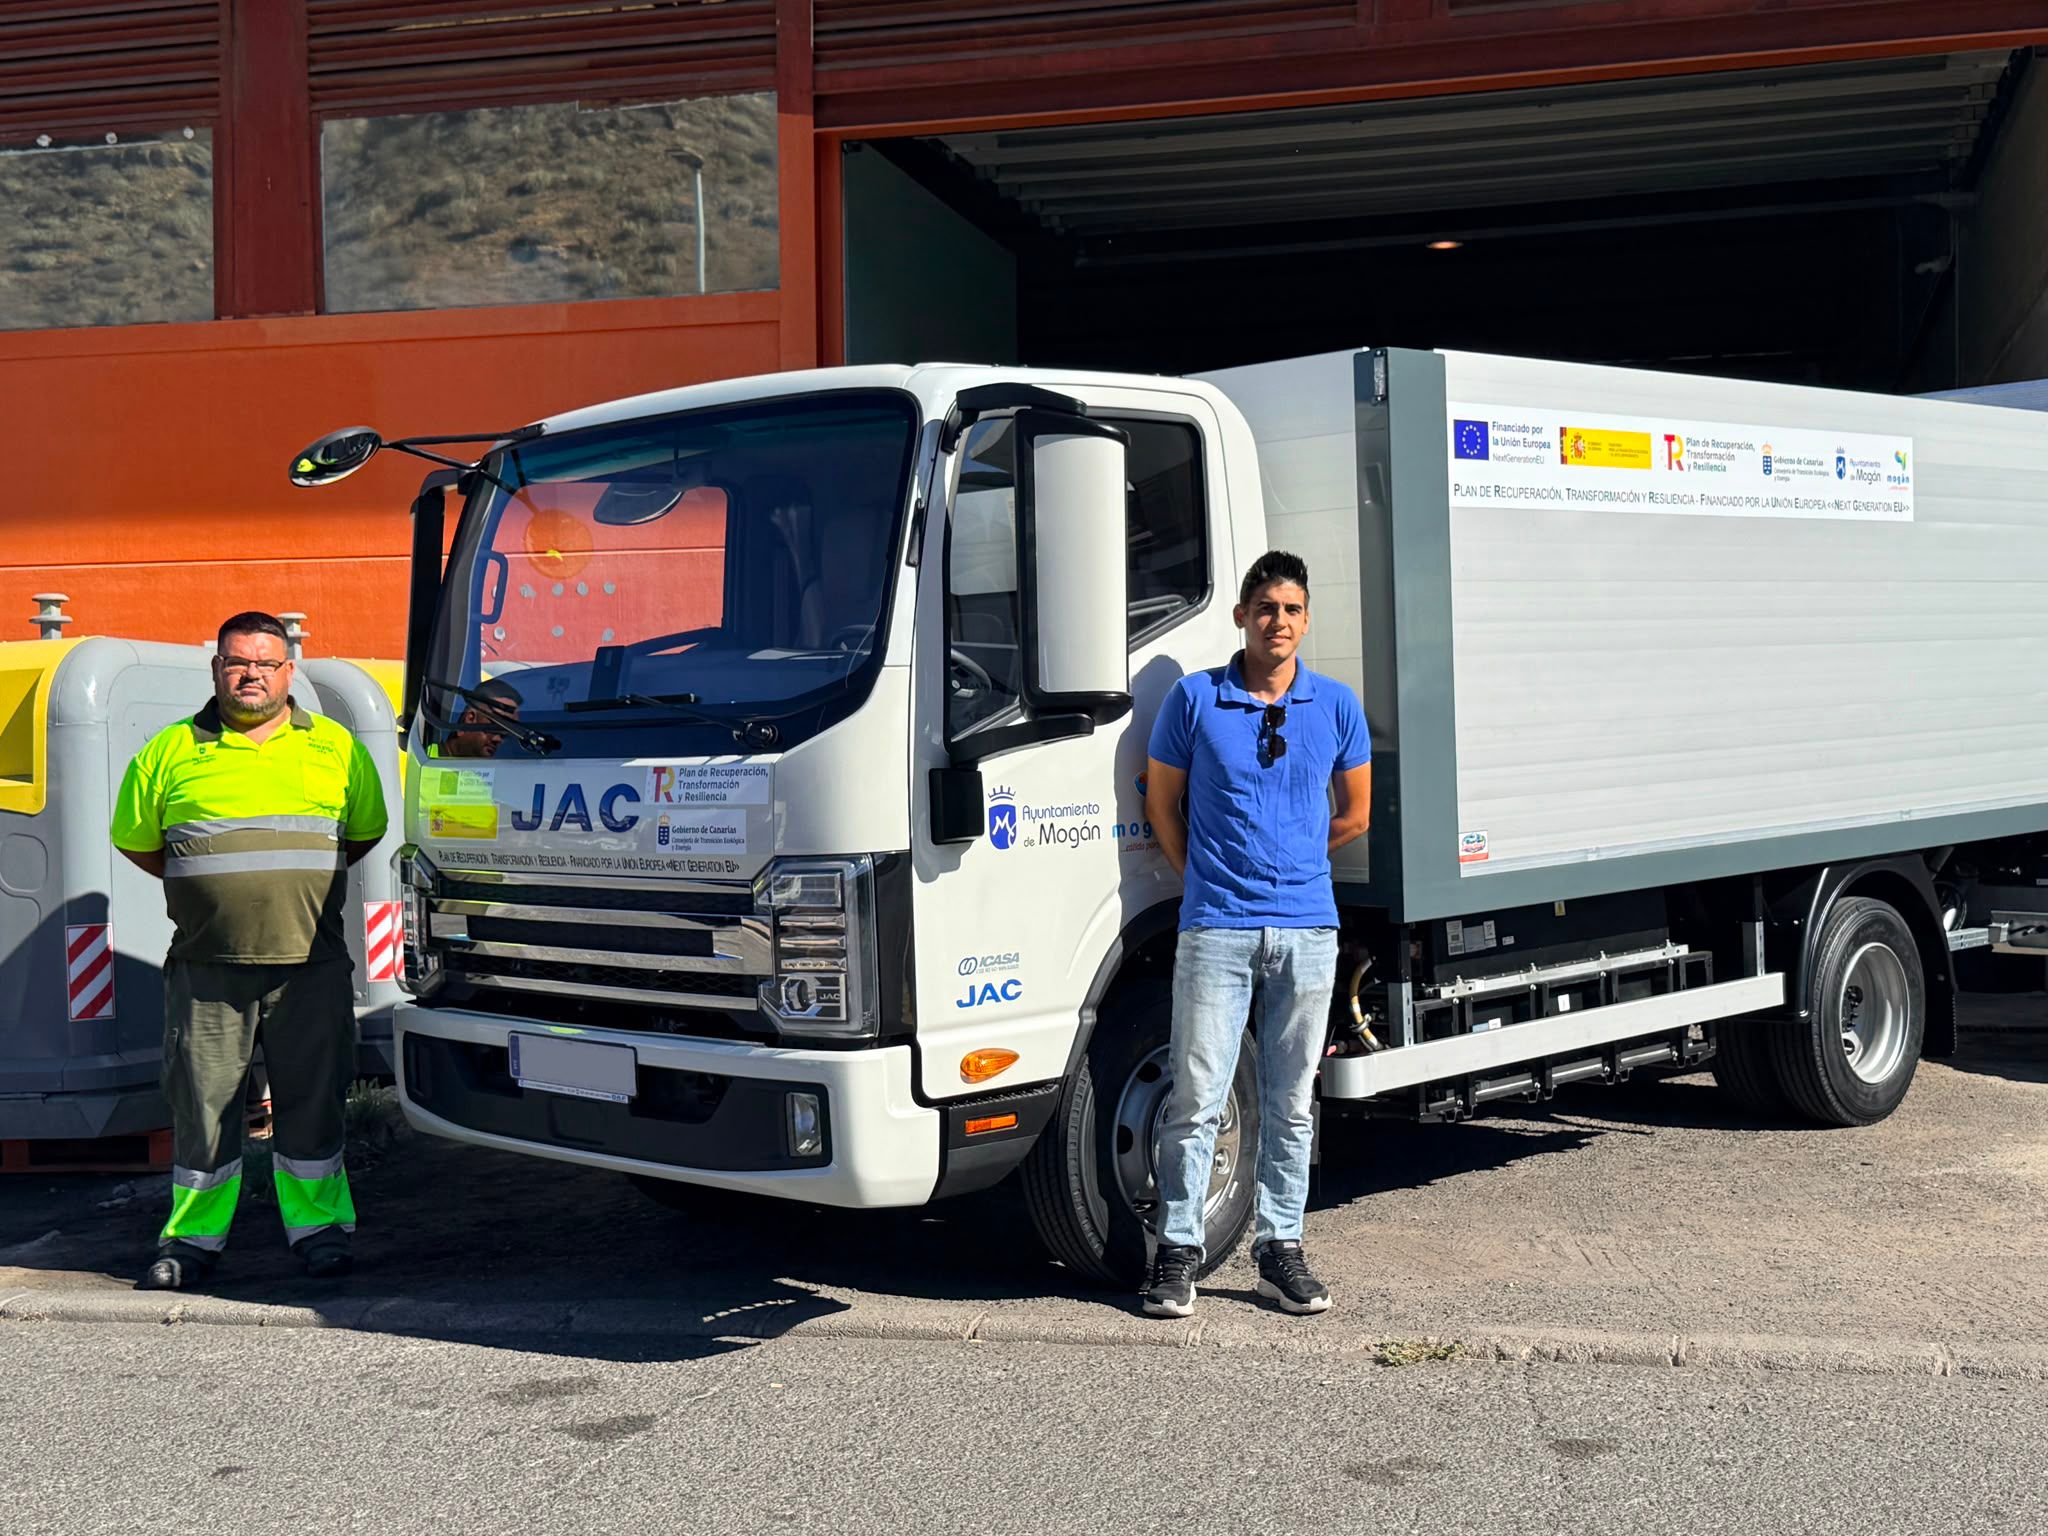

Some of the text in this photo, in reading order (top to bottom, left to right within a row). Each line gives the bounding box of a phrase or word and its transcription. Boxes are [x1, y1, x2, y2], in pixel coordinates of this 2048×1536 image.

[1492, 422, 1543, 435] Financiado por
[1492, 437, 1551, 450] la Unión Europea
[1686, 437, 1755, 452] Plan de Recuperación,
[1493, 454, 1544, 465] NextGenerationEU
[1686, 450, 1735, 462] Transformación
[1796, 457, 1802, 466] de
[1687, 462, 1727, 472] y Resiliencia
[1856, 468, 1881, 485] Mogán
[1454, 484, 1477, 497] PLAN
[1480, 486, 1492, 498] DE
[1494, 484, 1564, 502] RECUPERACIÓN,
[1566, 488, 1640, 504] TRANSFORMACIÓN
[1641, 492, 1647, 504] Y
[1649, 492, 1695, 506] RESILIENCIA
[1700, 494, 1744, 508] FINANCIADO
[1745, 496, 1760, 508] POR
[1762, 497, 1770, 508] LA
[1771, 497, 1793, 508] UNIÓN
[1794, 497, 1826, 510] EUROPEA
[1853, 500, 1892, 512] GENERATION
[679, 768, 768, 778] Plan de Recuperación,
[678, 780, 739, 790] Transformación
[678, 792, 727, 803] y Resiliencia
[511, 784, 640, 832] JAC
[1022, 802, 1100, 824] Ayuntamiento
[672, 825, 736, 834] Gobierno de Canarias
[1024, 820, 1100, 848] de Mogán
[1112, 822, 1152, 839] mog
[601, 858, 614, 869] POR
[615, 859, 621, 870] LA
[979, 952, 1019, 968] ICASA
[956, 978, 1022, 1008] JAC
